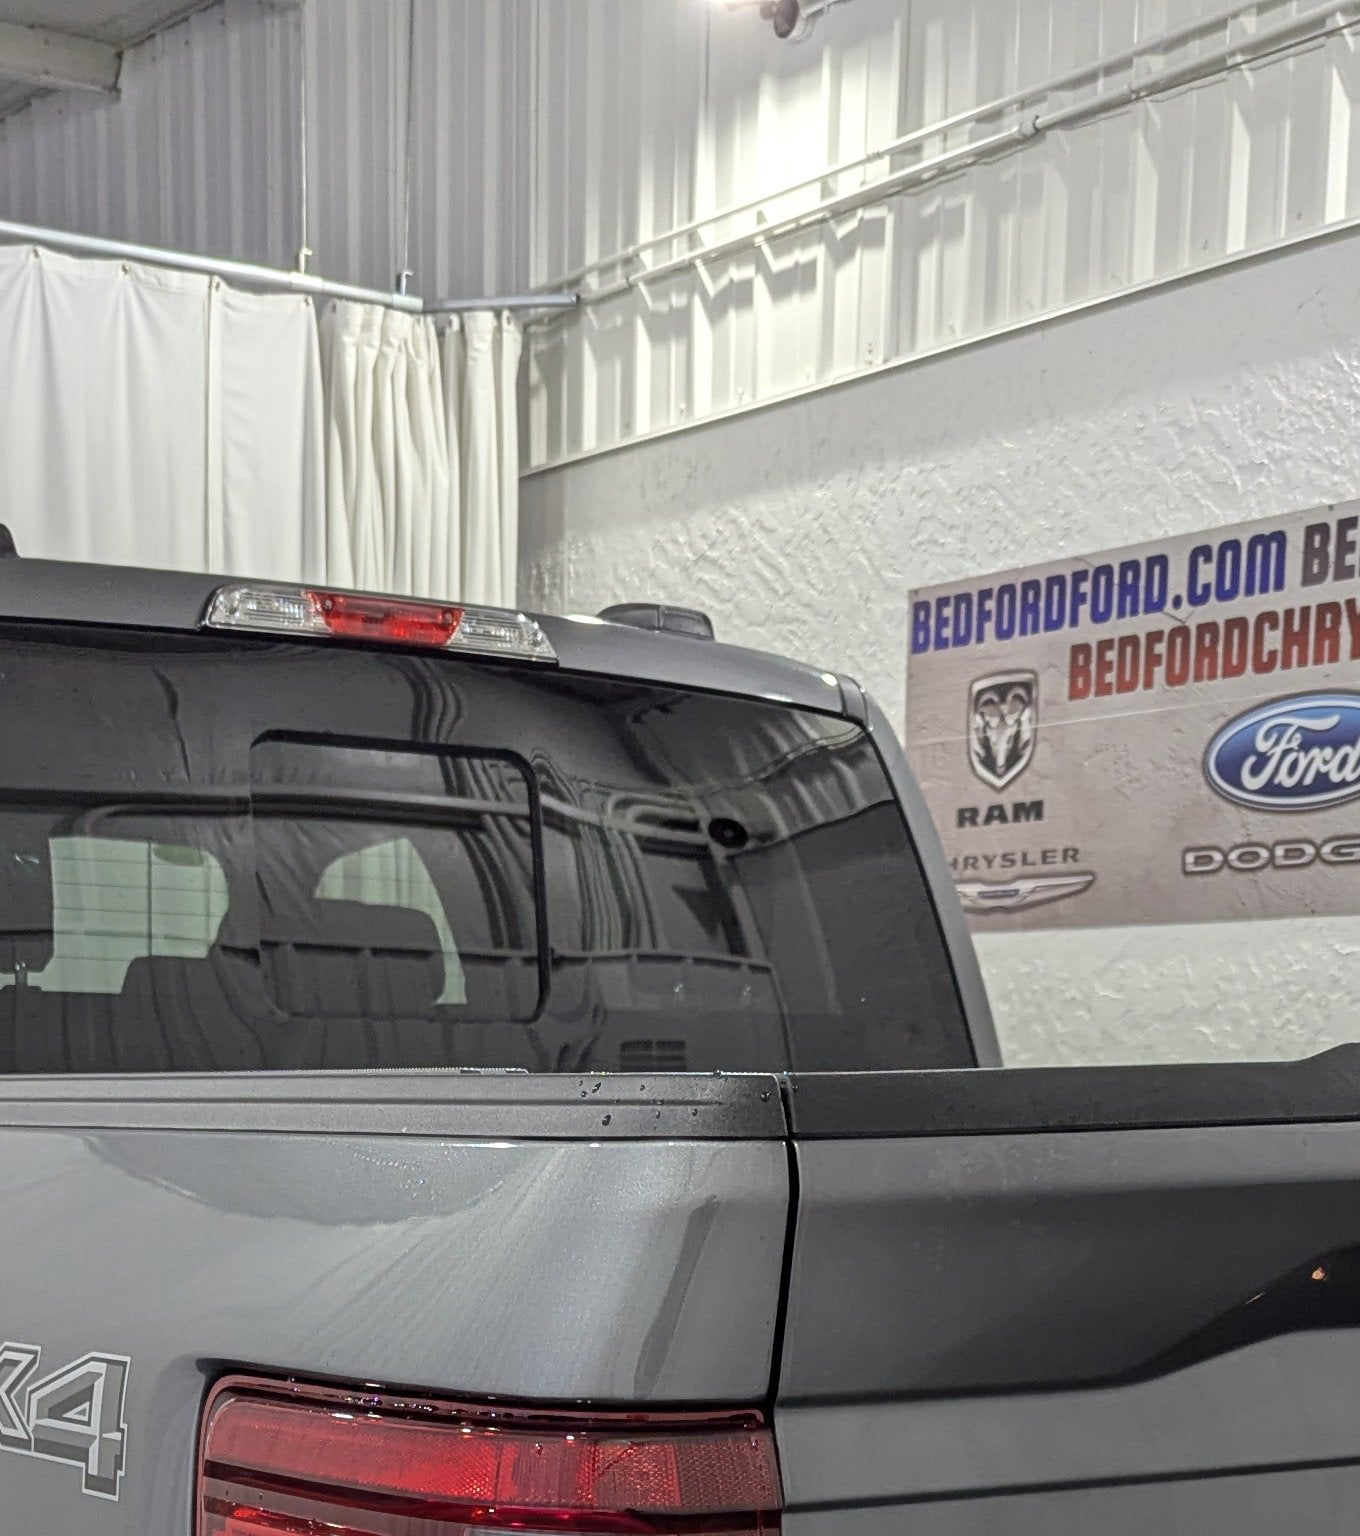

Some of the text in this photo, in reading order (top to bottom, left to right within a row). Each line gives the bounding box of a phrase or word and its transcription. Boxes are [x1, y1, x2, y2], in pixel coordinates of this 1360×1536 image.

[911, 530, 1287, 655] BEDFORDFORD.COM
[956, 800, 1045, 829] RAM
[949, 847, 1081, 871] HRYSLER
